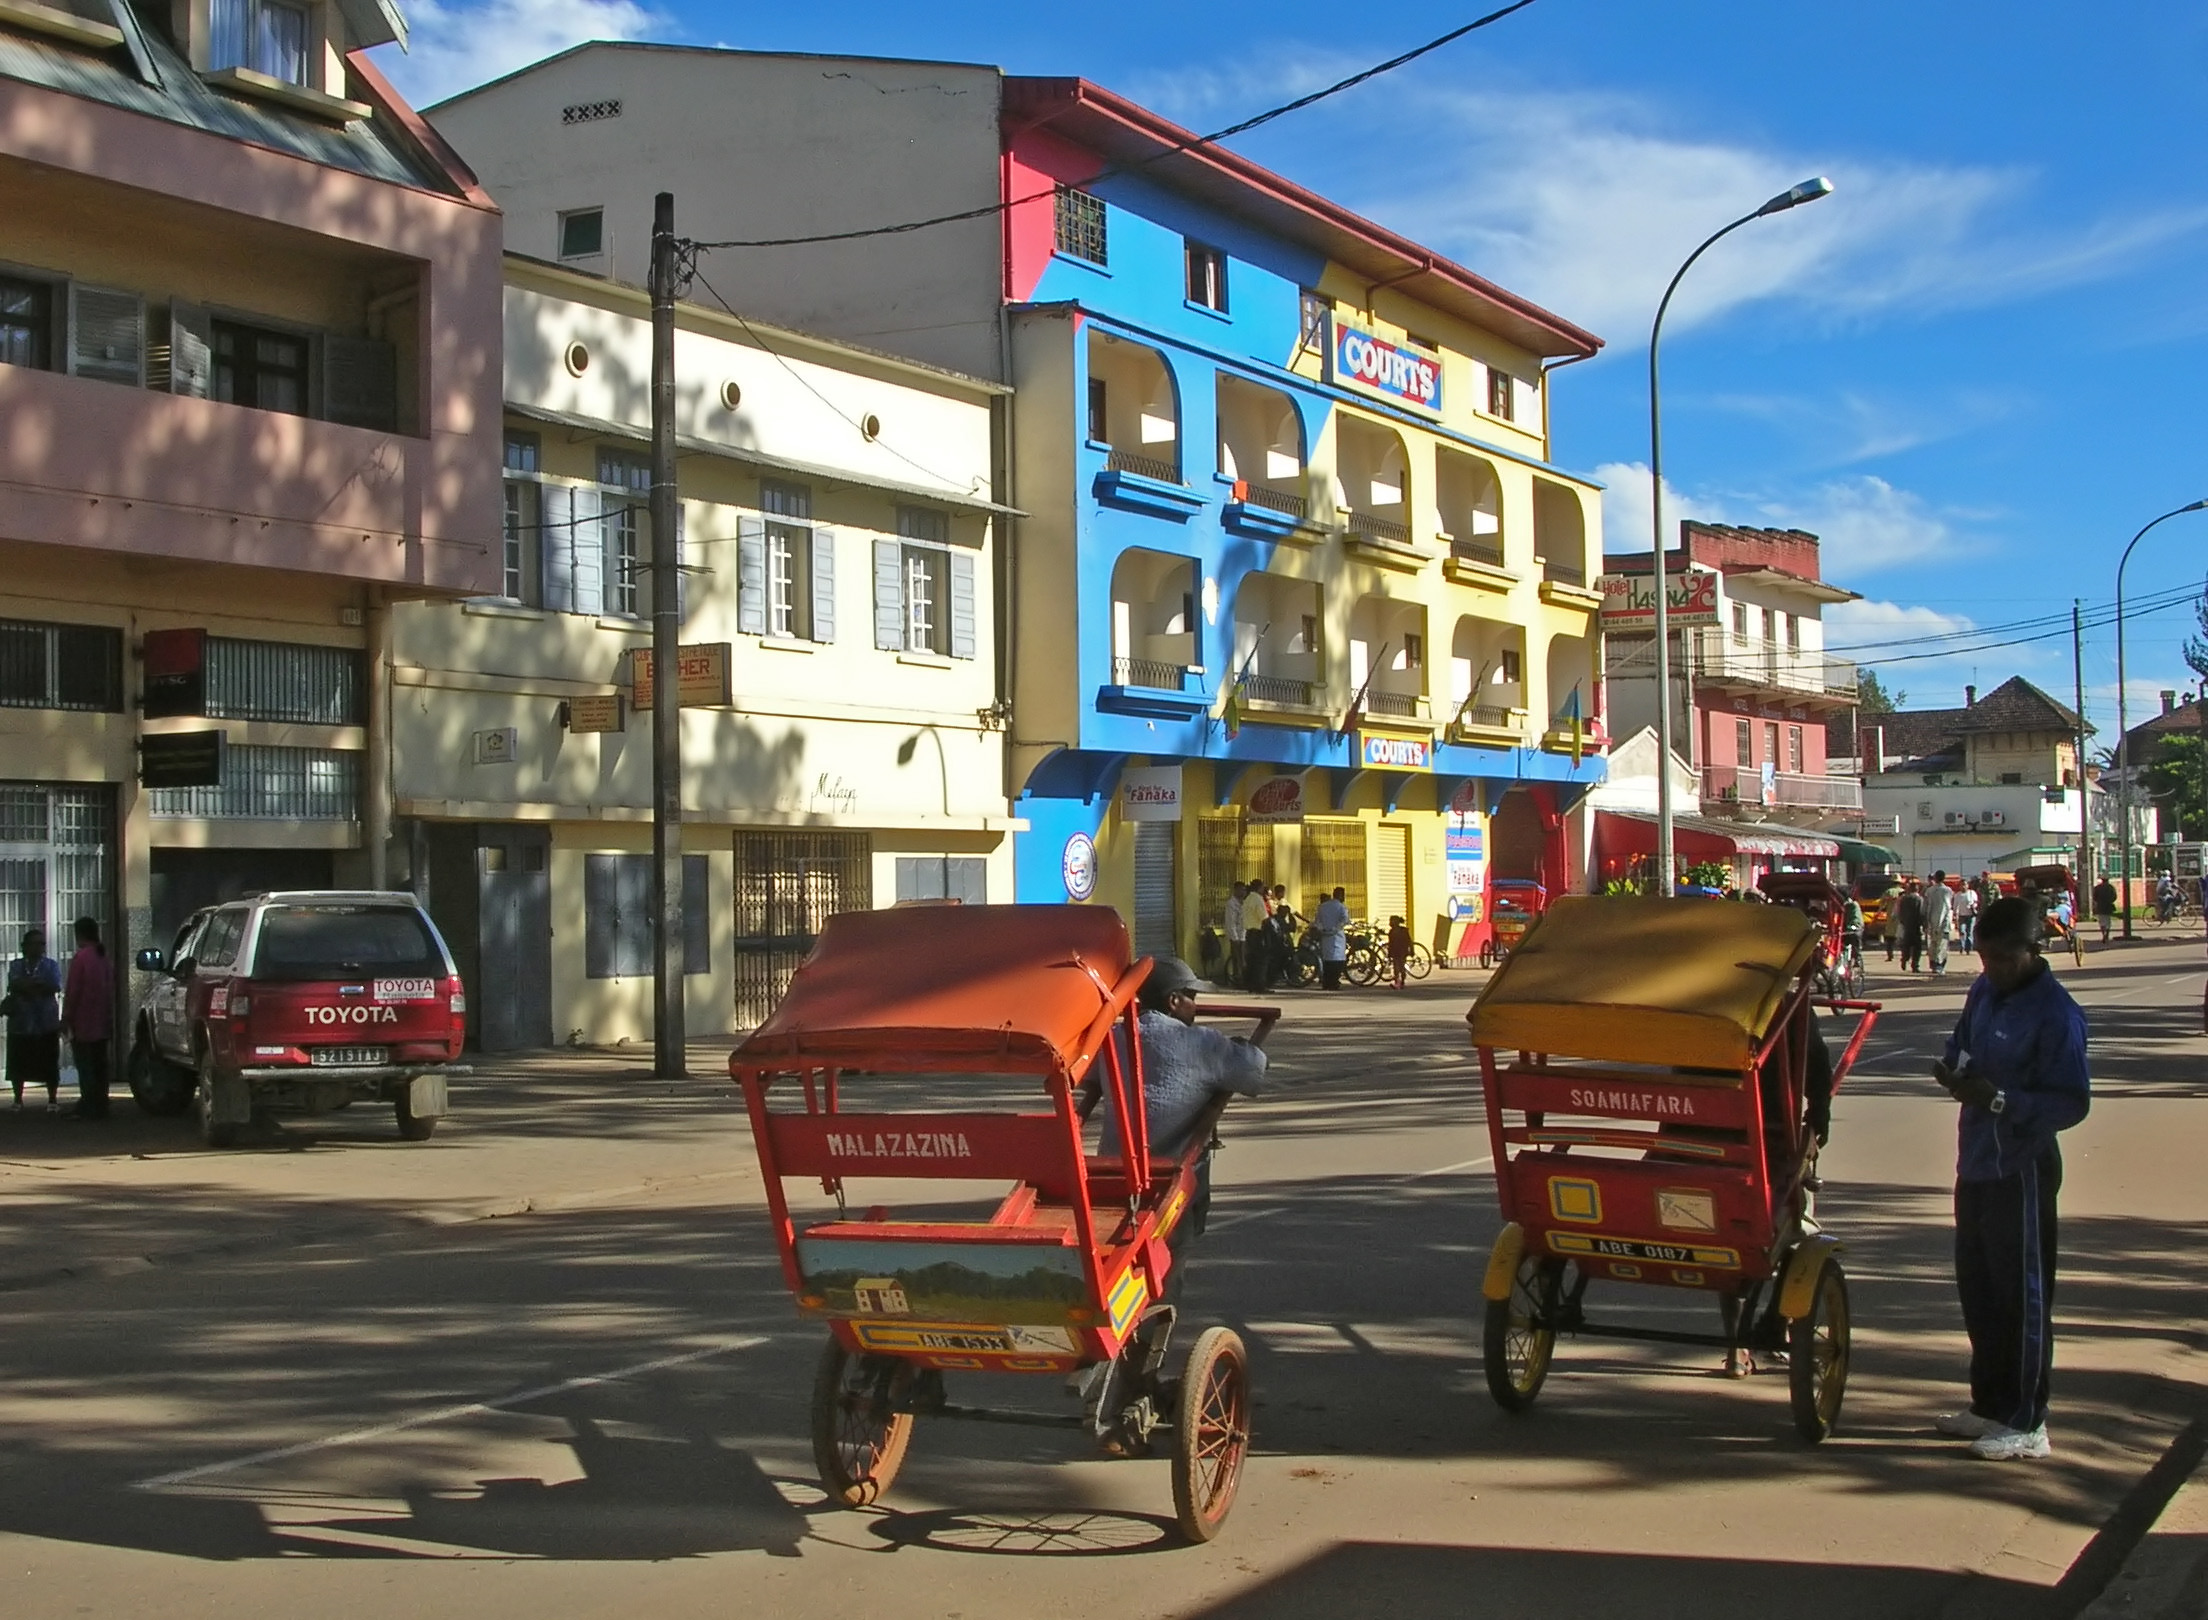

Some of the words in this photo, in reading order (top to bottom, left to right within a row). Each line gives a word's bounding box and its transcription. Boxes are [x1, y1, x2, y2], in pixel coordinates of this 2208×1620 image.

[1345, 336, 1435, 401] COURTS
[1627, 579, 1689, 609] HASNA
[1370, 738, 1424, 766] COURTS
[1130, 788, 1176, 801] Fanaka
[376, 979, 433, 993] TOYOTA
[304, 1006, 398, 1024] TOYOTA
[1570, 1089, 1695, 1116] SOAMIAFARA
[826, 1133, 971, 1158] MALAZAZINA
[1599, 1240, 1635, 1257] ABE
[1645, 1245, 1688, 1261] 0187
